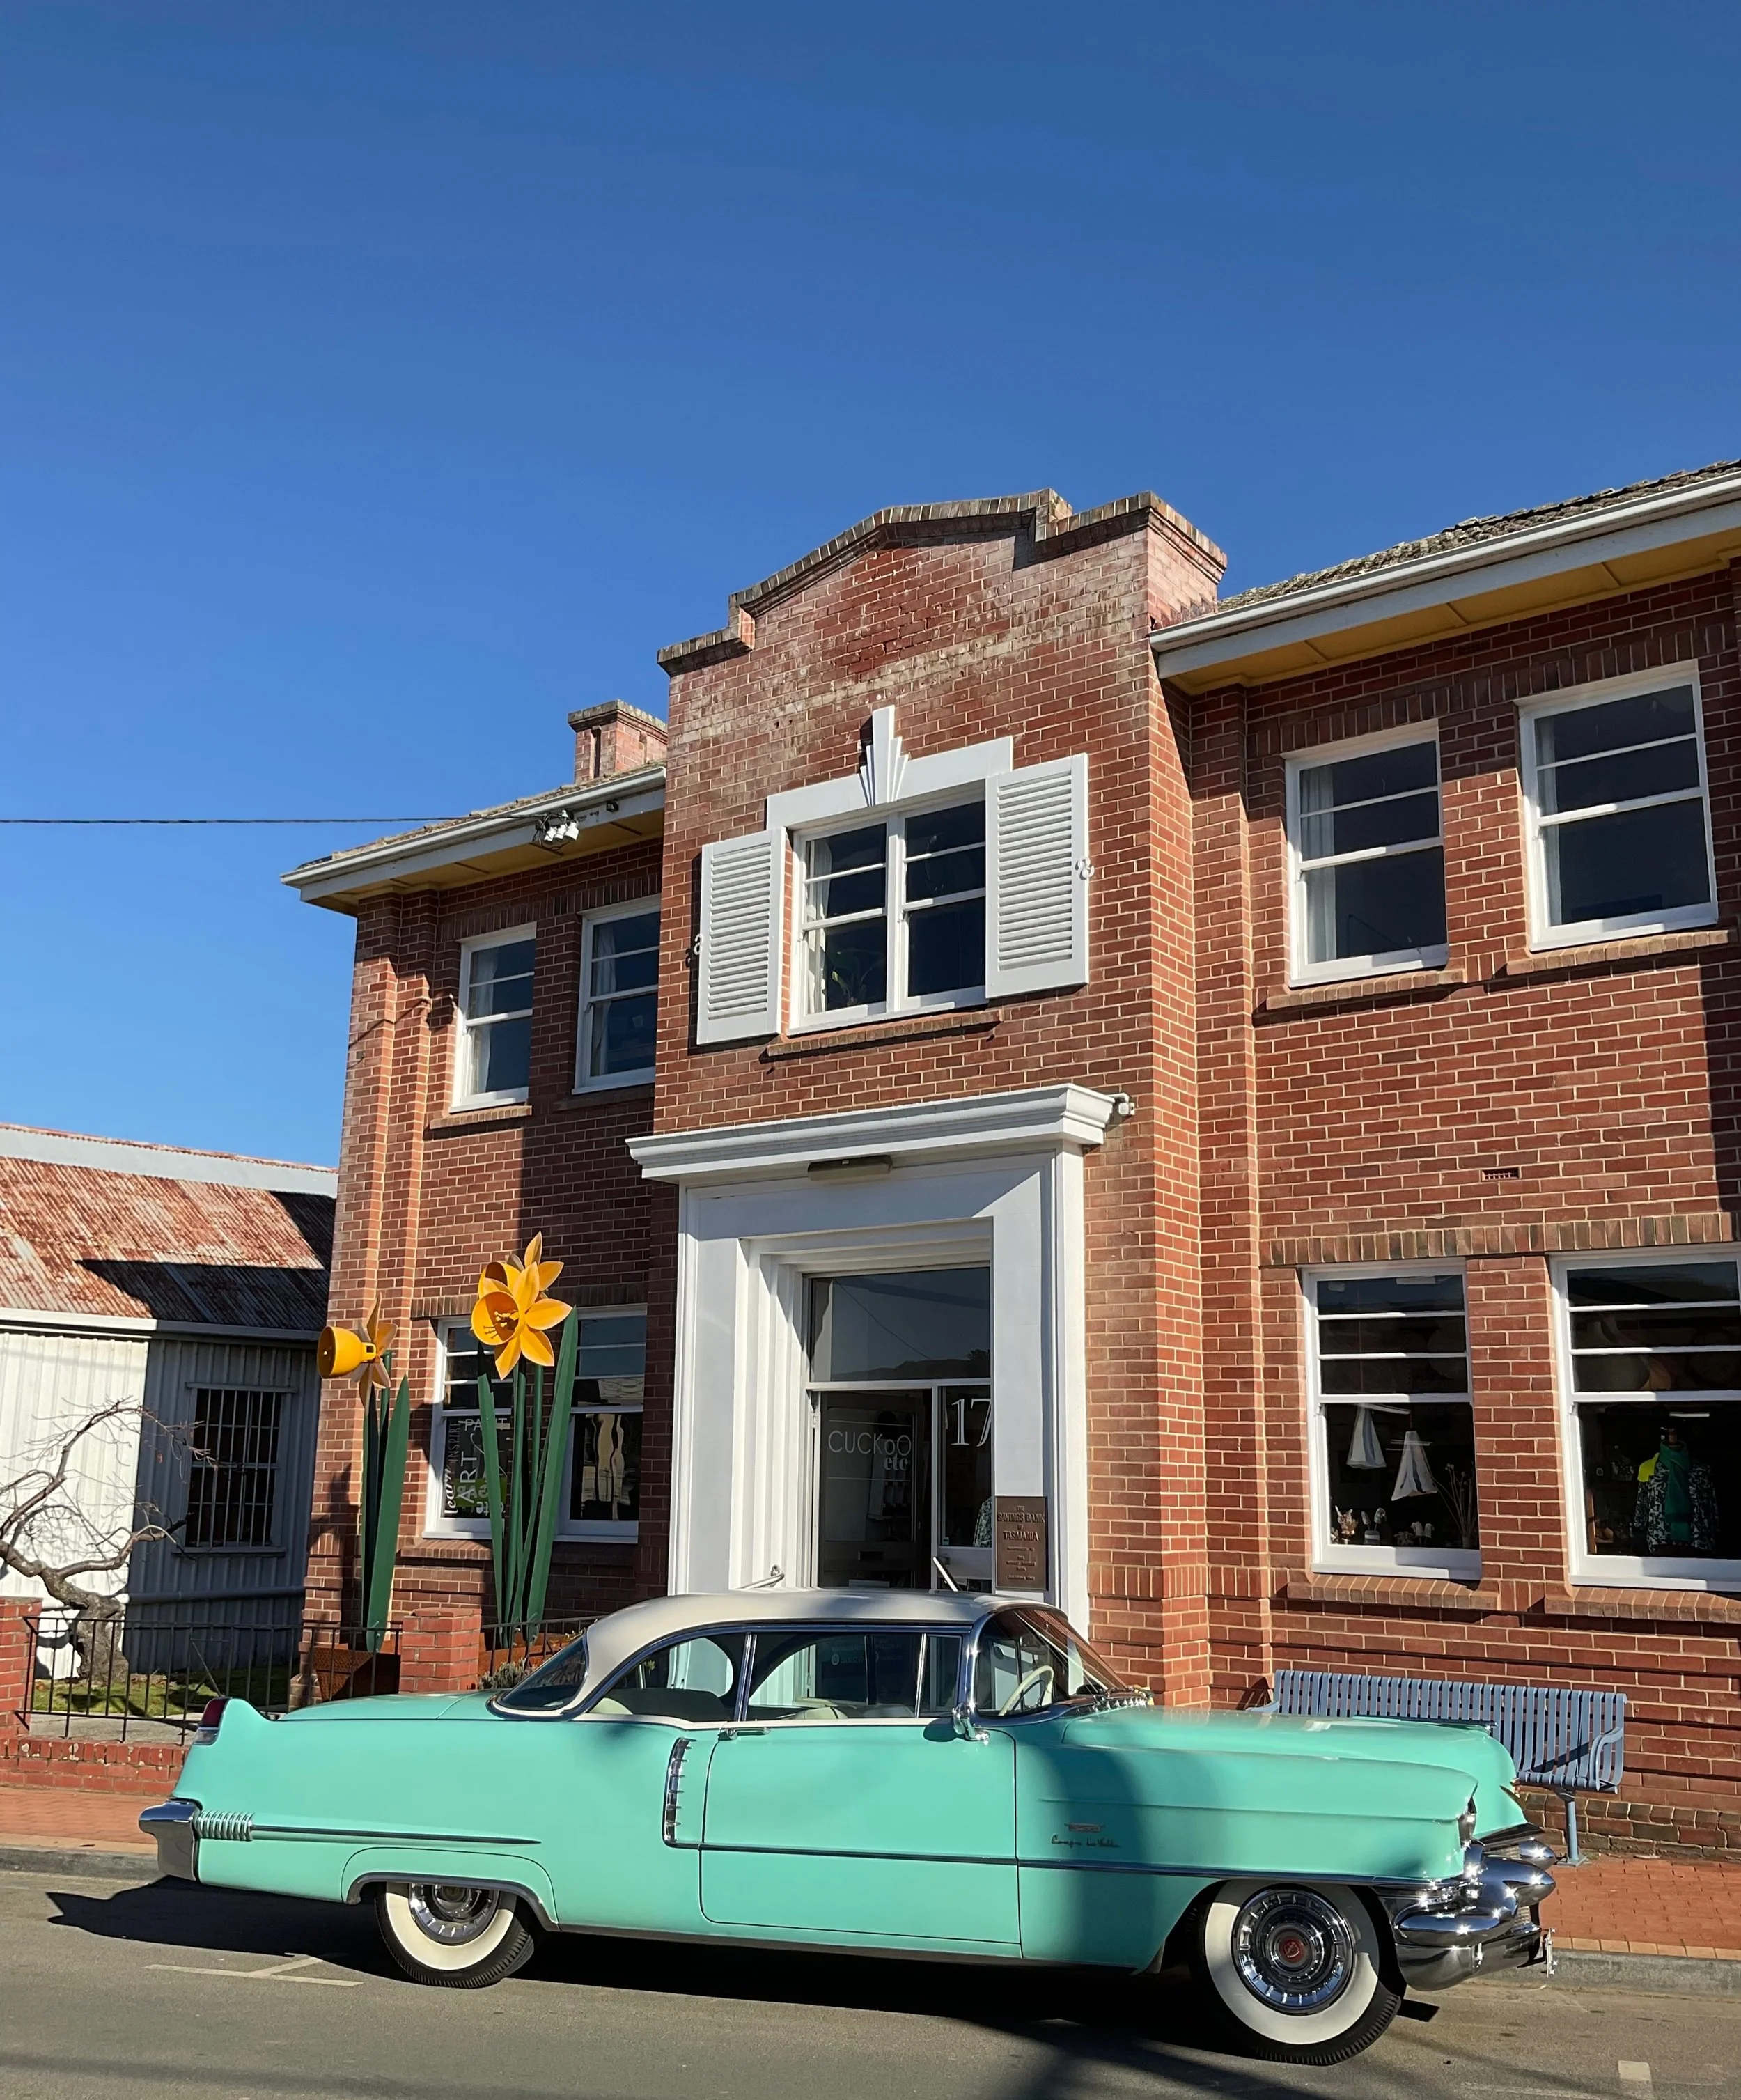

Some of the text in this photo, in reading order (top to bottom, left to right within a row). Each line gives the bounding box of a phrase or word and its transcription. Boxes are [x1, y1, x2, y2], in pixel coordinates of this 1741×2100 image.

[464, 1417, 507, 1431] PAT
[951, 1398, 992, 1447] 17
[884, 1456, 908, 1471] etc
[459, 1451, 477, 1504] ART
[444, 1465, 458, 1514] learn
[997, 1512, 1045, 1523] SAVINGS BANK
[1003, 1530, 1039, 1541] TASMANIA
